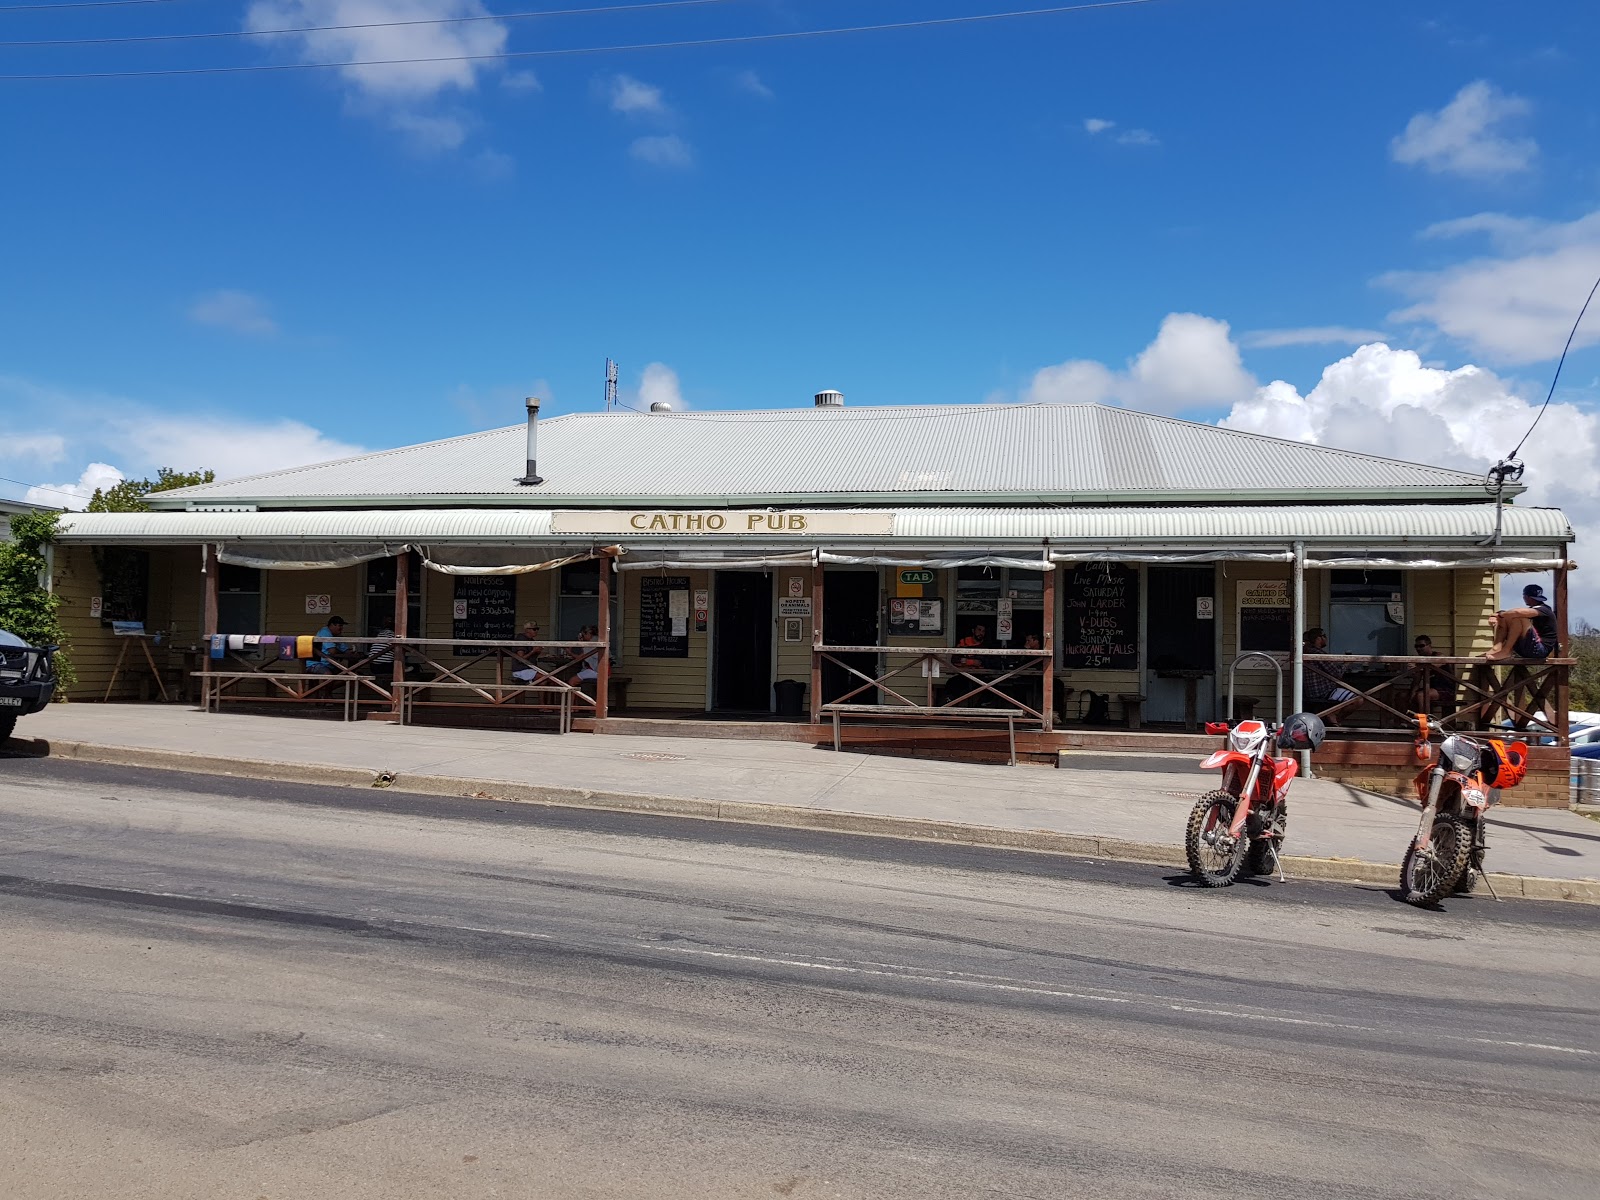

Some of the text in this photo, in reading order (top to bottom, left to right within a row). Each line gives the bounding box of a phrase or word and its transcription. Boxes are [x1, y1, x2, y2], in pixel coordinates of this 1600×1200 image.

[630, 513, 808, 530] CATHO PUB
[1096, 574, 1125, 586] Music
[1083, 586, 1125, 597] SATURDAY
[1067, 599, 1126, 608] JOHN LARDER
[1080, 635, 1112, 644] SUNDAY
[1066, 642, 1136, 655] HURRICANE FALLS
